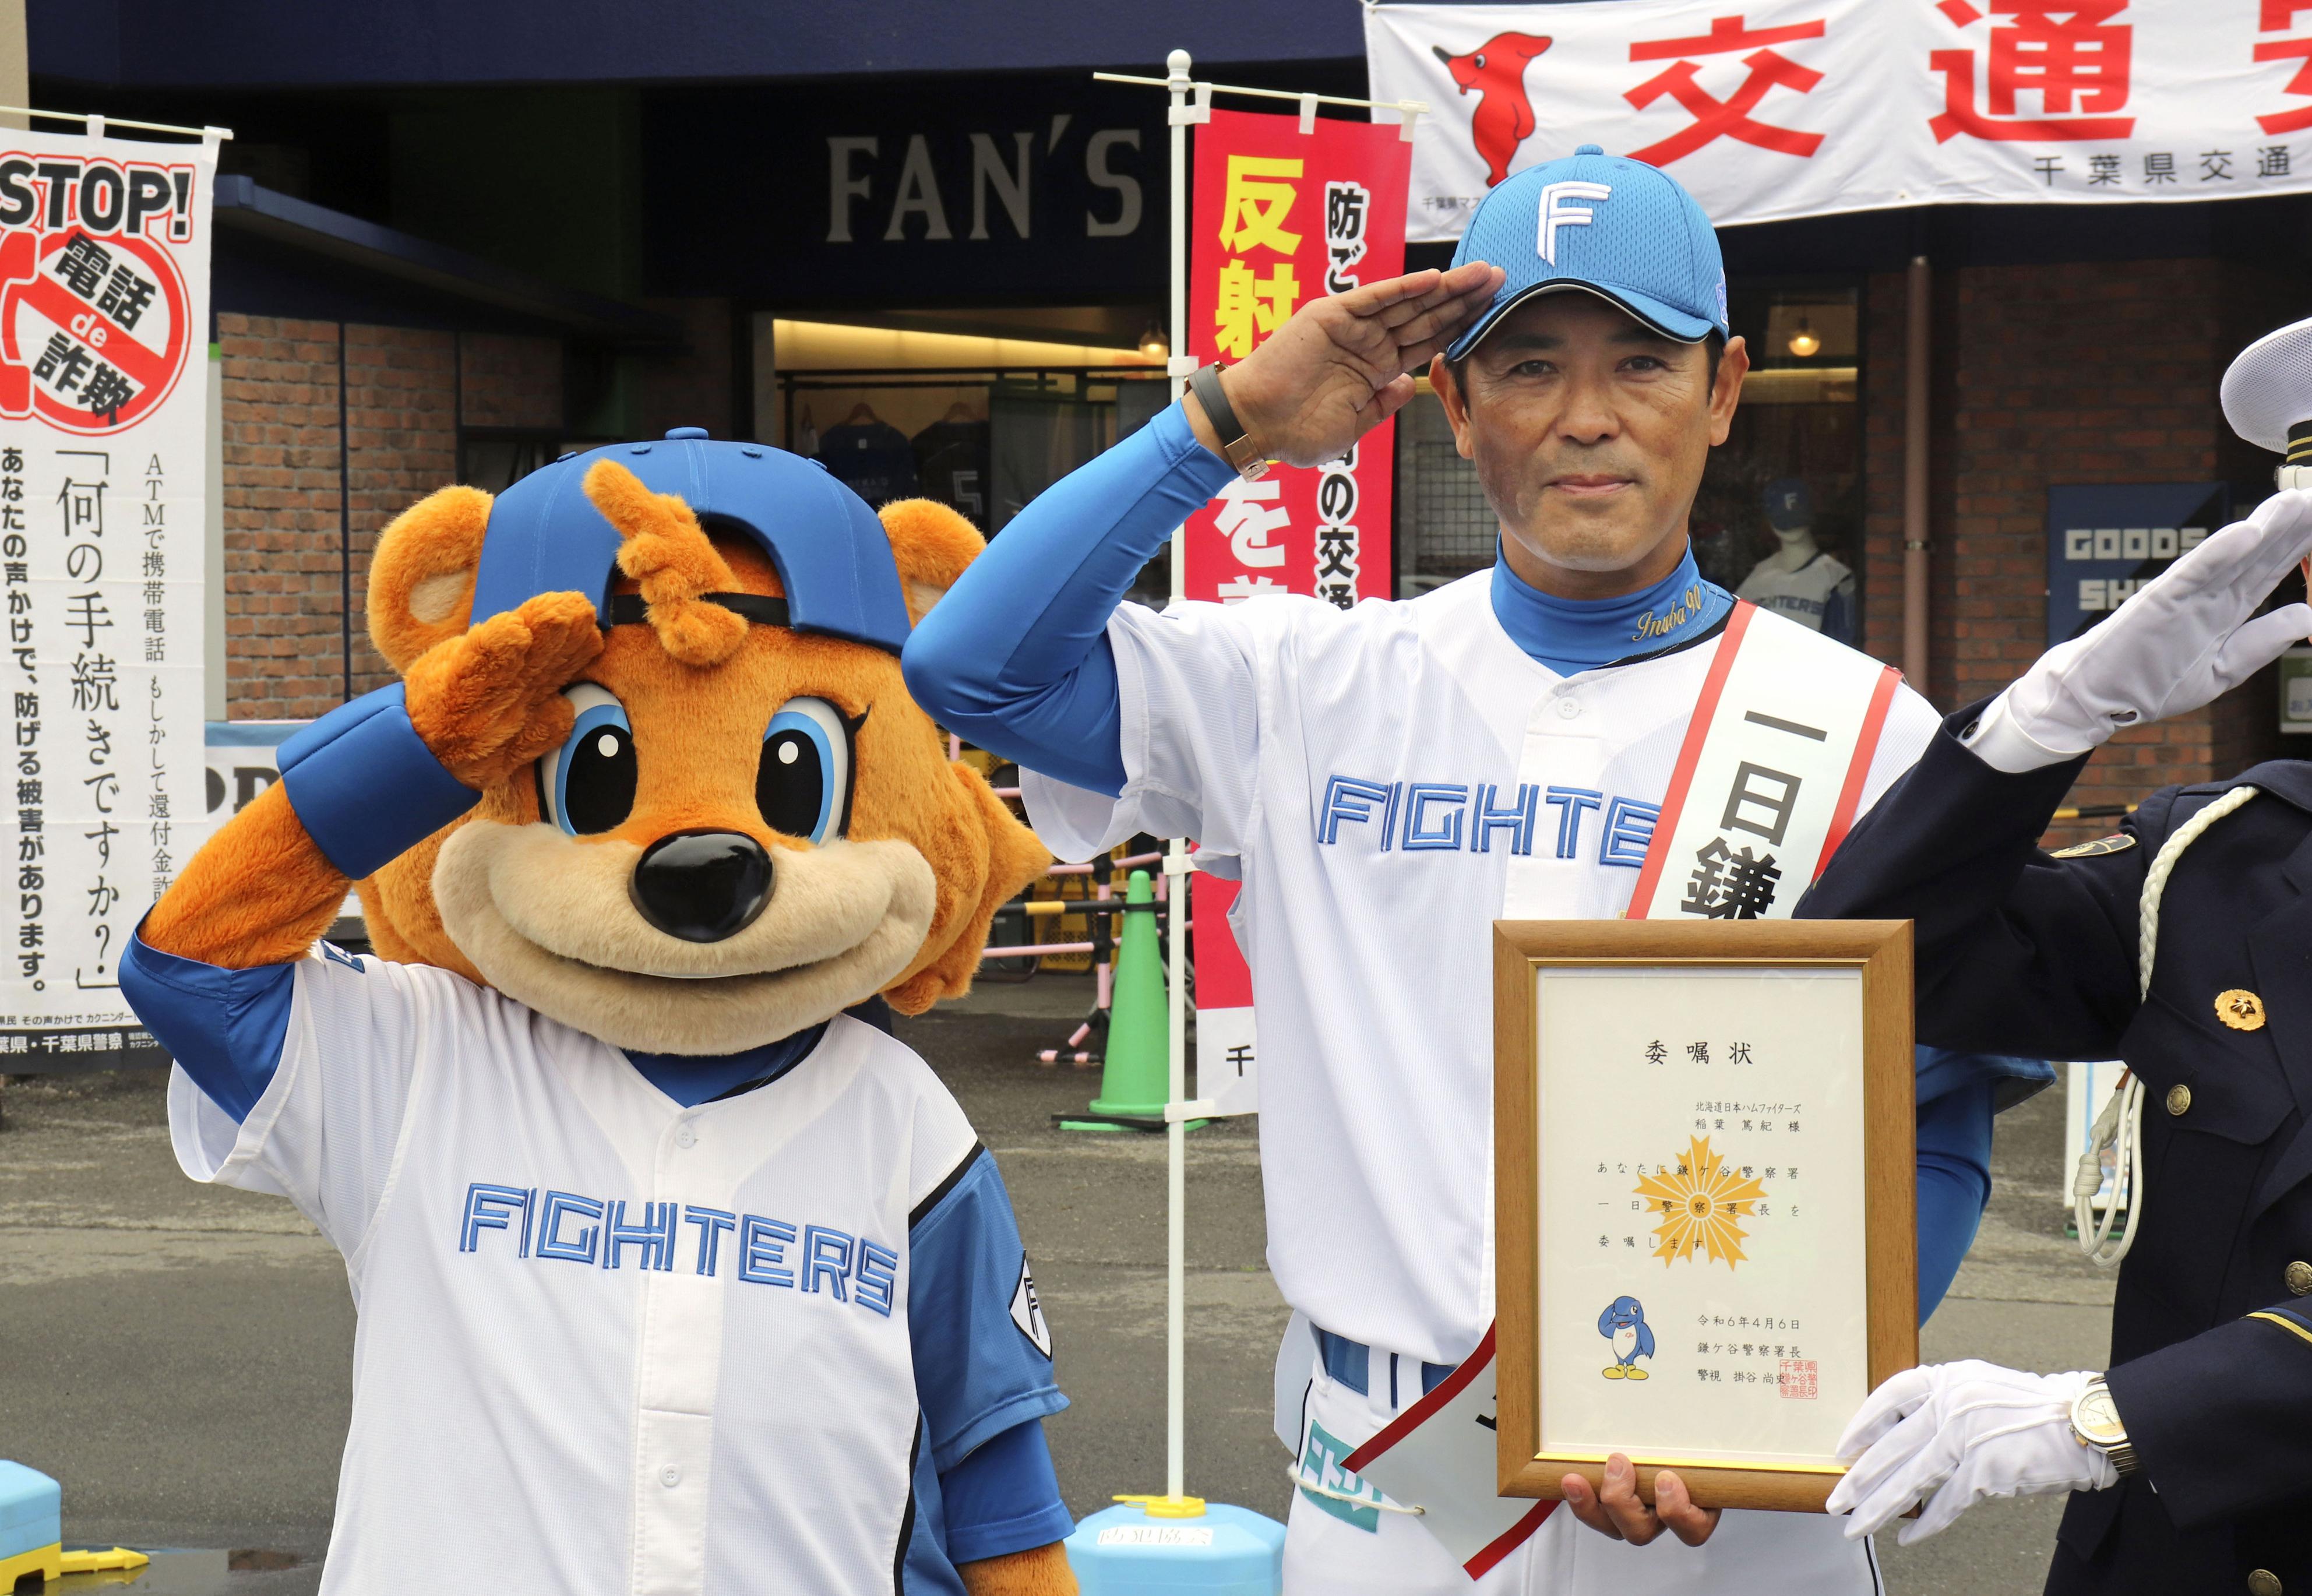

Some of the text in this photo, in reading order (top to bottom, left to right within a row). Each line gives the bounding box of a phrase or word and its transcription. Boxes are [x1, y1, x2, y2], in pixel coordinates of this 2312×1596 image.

[826, 115, 1143, 242] FAN'S
[2033, 146, 2290, 186] 千葉県交通
[0, 159, 190, 235] STOP!
[1537, 181, 1612, 267] F
[54, 232, 156, 332] 電話
[70, 313, 107, 348] de
[33, 331, 135, 426] 詐欺
[142, 453, 165, 662] ATMで携帯電話
[2065, 528, 2208, 560] GOODS
[2078, 579, 2156, 611] SH
[1681, 710, 1828, 919] 一日鎌
[22, 1014, 82, 1026] その声かけで
[1226, 1045, 1254, 1077] 千
[1645, 1040, 1753, 1065] 委嘱状
[1696, 1101, 1802, 1114] 北海道日本ハムファイターズ
[1695, 1119, 1800, 1132] 稲葉 篤紀 様
[1598, 1199, 1800, 1217] 一日警察署長を
[460, 1182, 898, 1317] FIGHTERS
[1599, 1234, 1704, 1250] 委嘱します
[1697, 1315, 1800, 1330] 令和6年4月6日
[1697, 1369, 1721, 1382] 警視
